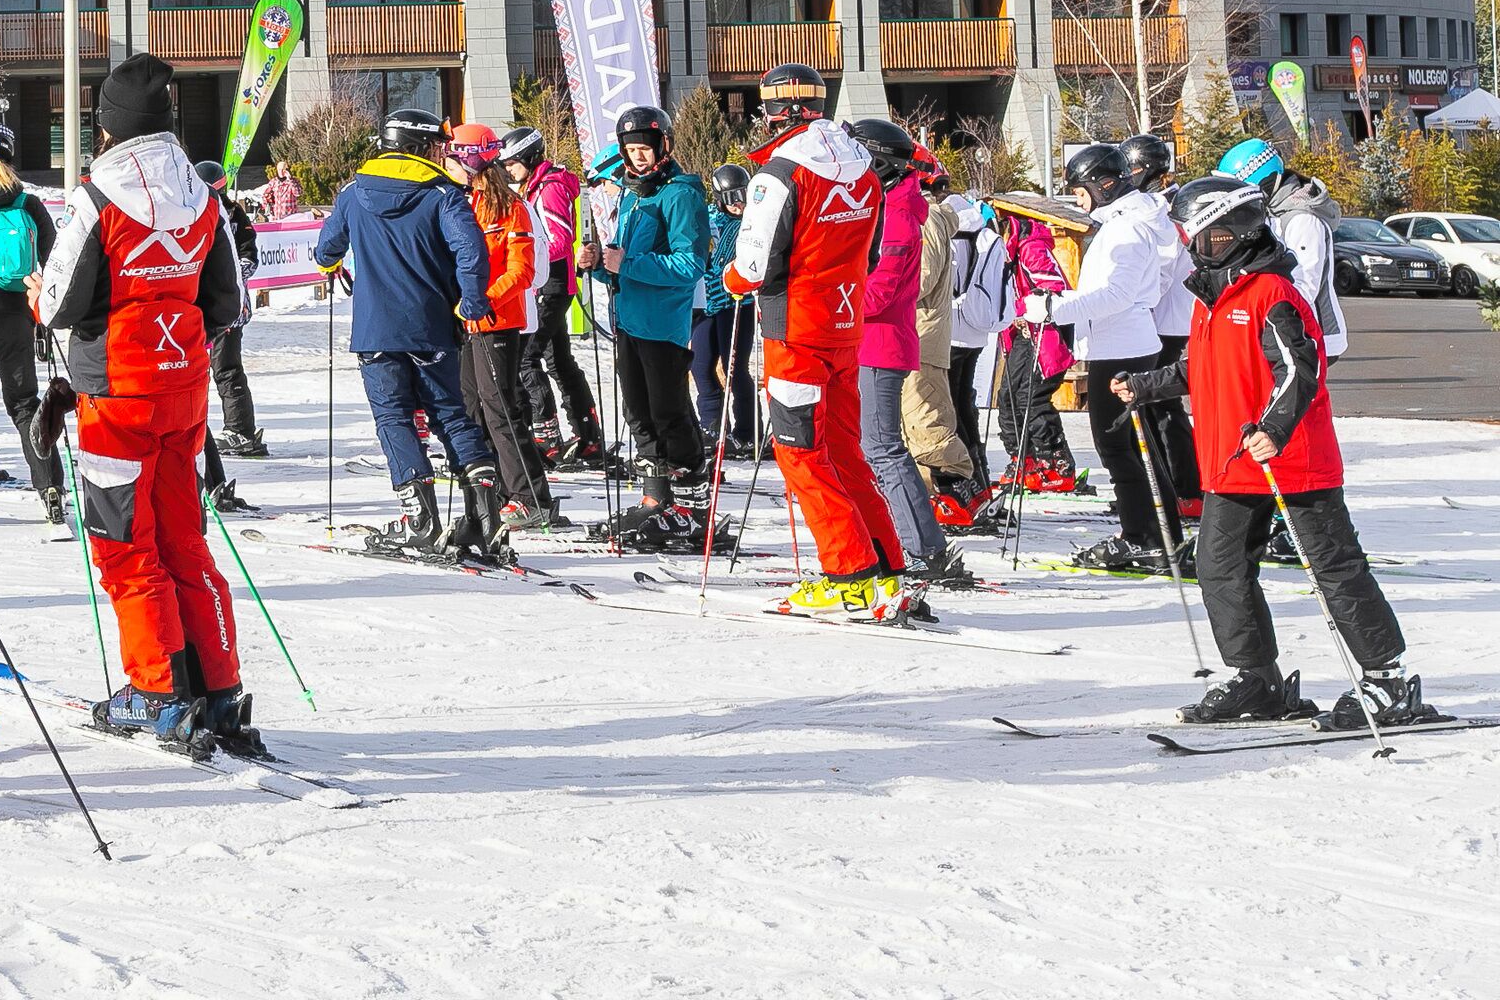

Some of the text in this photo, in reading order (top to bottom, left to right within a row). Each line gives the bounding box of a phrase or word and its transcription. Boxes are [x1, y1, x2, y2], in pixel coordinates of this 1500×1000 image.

[1408, 68, 1448, 85] NOLEGGIO
[385, 119, 440, 132] SALICE
[260, 242, 298, 266] bardo.ski
[119, 260, 202, 276] NORDOVEST
[157, 360, 189, 370] XERJOFF
[202, 570, 230, 652] NORDOVEST
